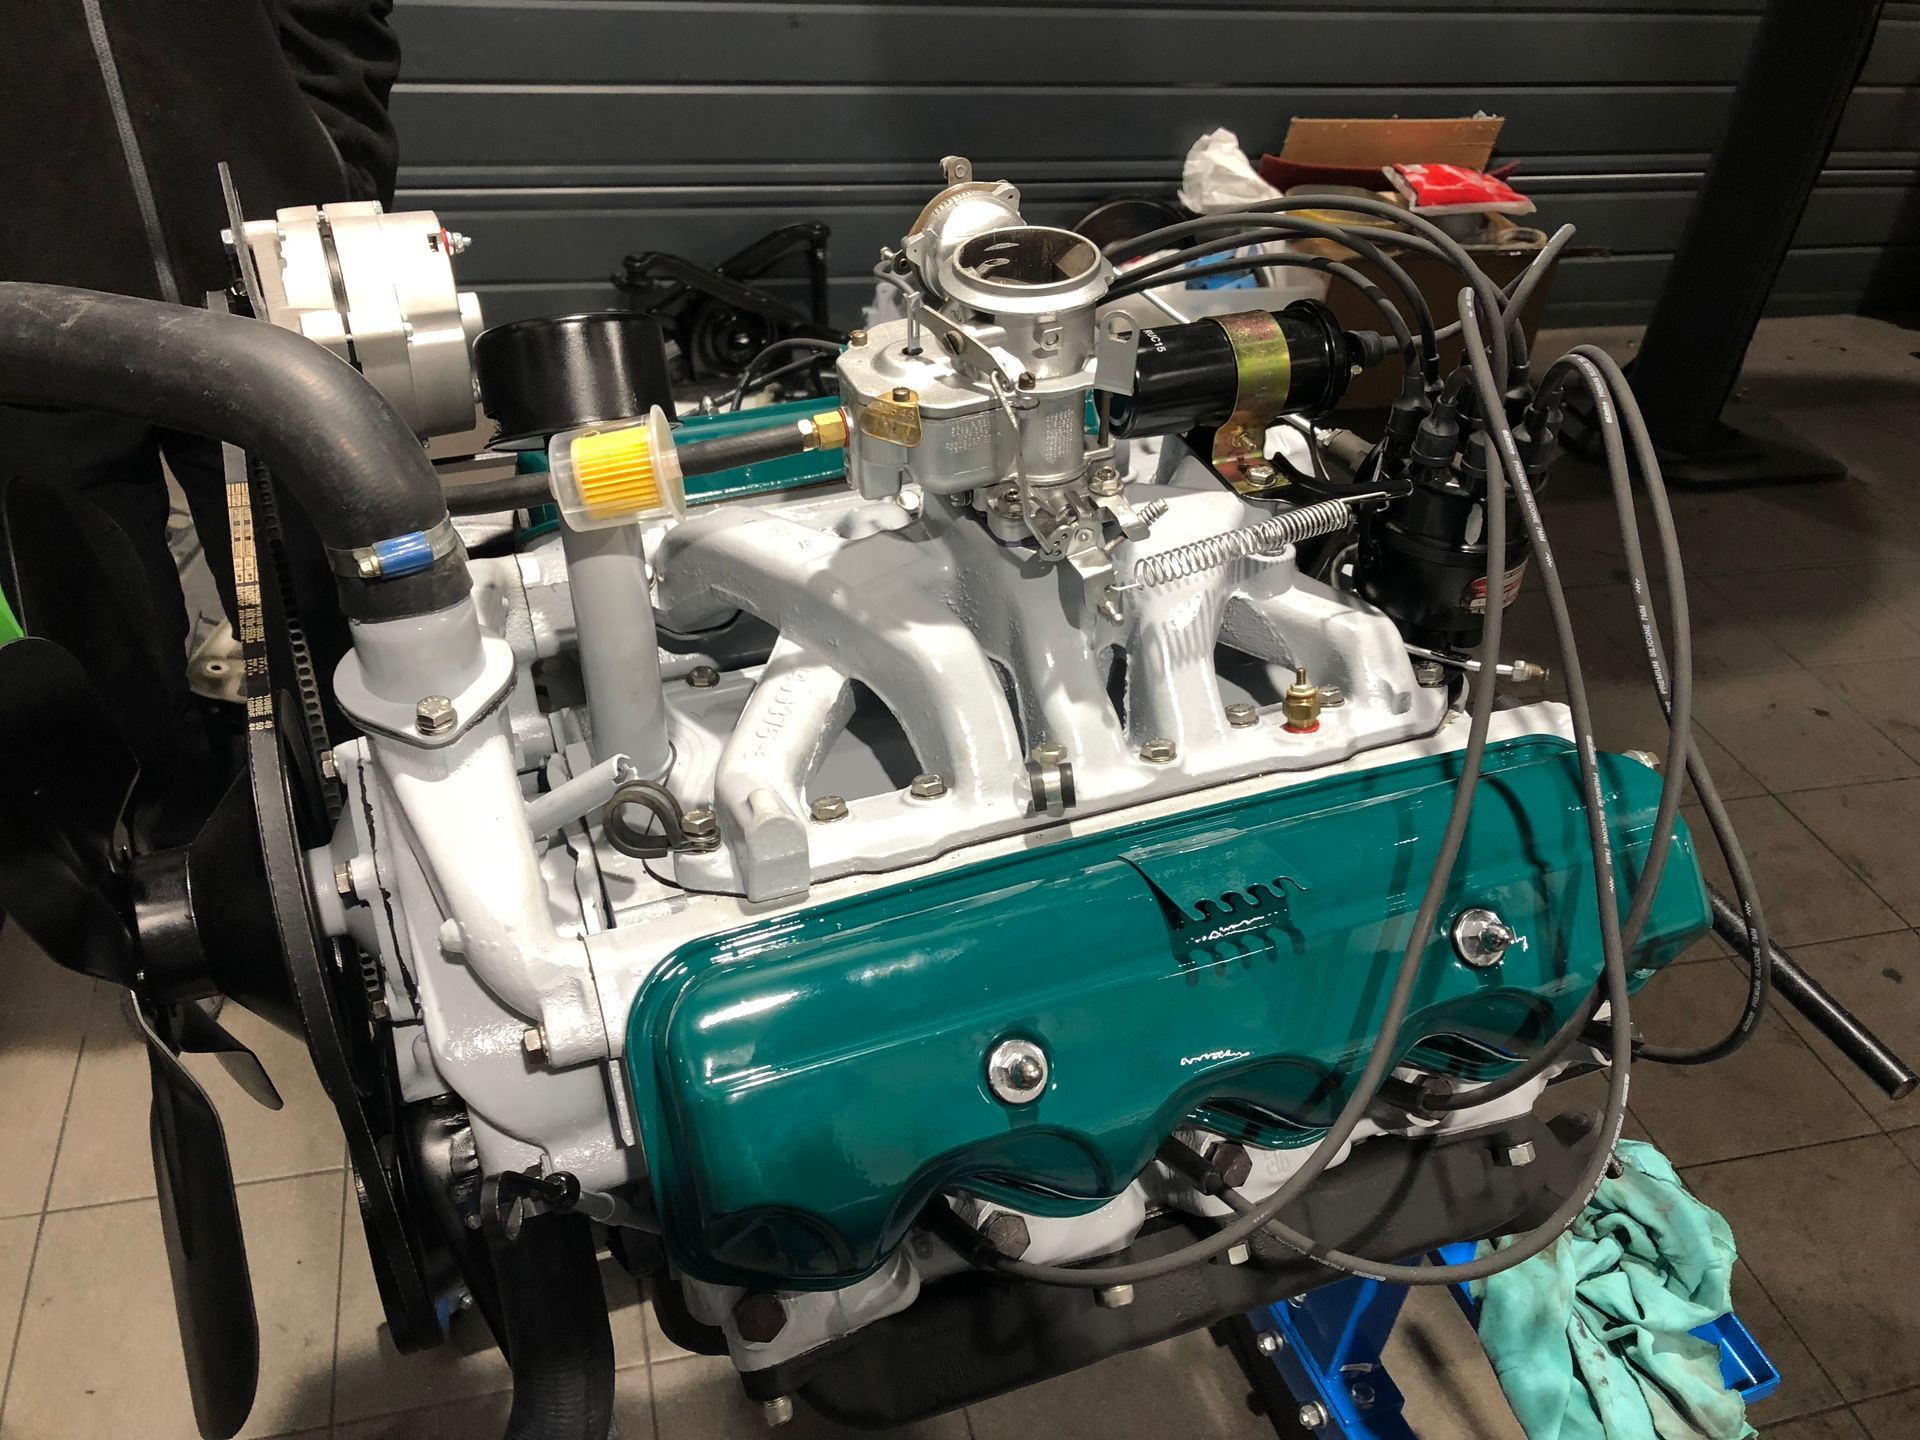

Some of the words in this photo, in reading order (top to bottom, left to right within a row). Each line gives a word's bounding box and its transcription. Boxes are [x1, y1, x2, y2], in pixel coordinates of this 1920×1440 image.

[1142, 329, 1167, 353] RUC15
[1513, 460, 1529, 491] PREMIUM
[1524, 493, 1540, 524] SILICONE
[1536, 525, 1546, 542] 7MM
[1638, 605, 1648, 621] 7MM
[1642, 624, 1657, 658] SILICONE
[1651, 660, 1668, 694] PREMIUM
[1592, 772, 1604, 807] PREMIUM
[1598, 809, 1610, 845] SILICONE
[1604, 847, 1612, 865] 7MM
[1610, 1113, 1624, 1150] PREMIUM
[1594, 1152, 1612, 1187] SILICONE
[1309, 1254, 1346, 1271] PREMIUM
